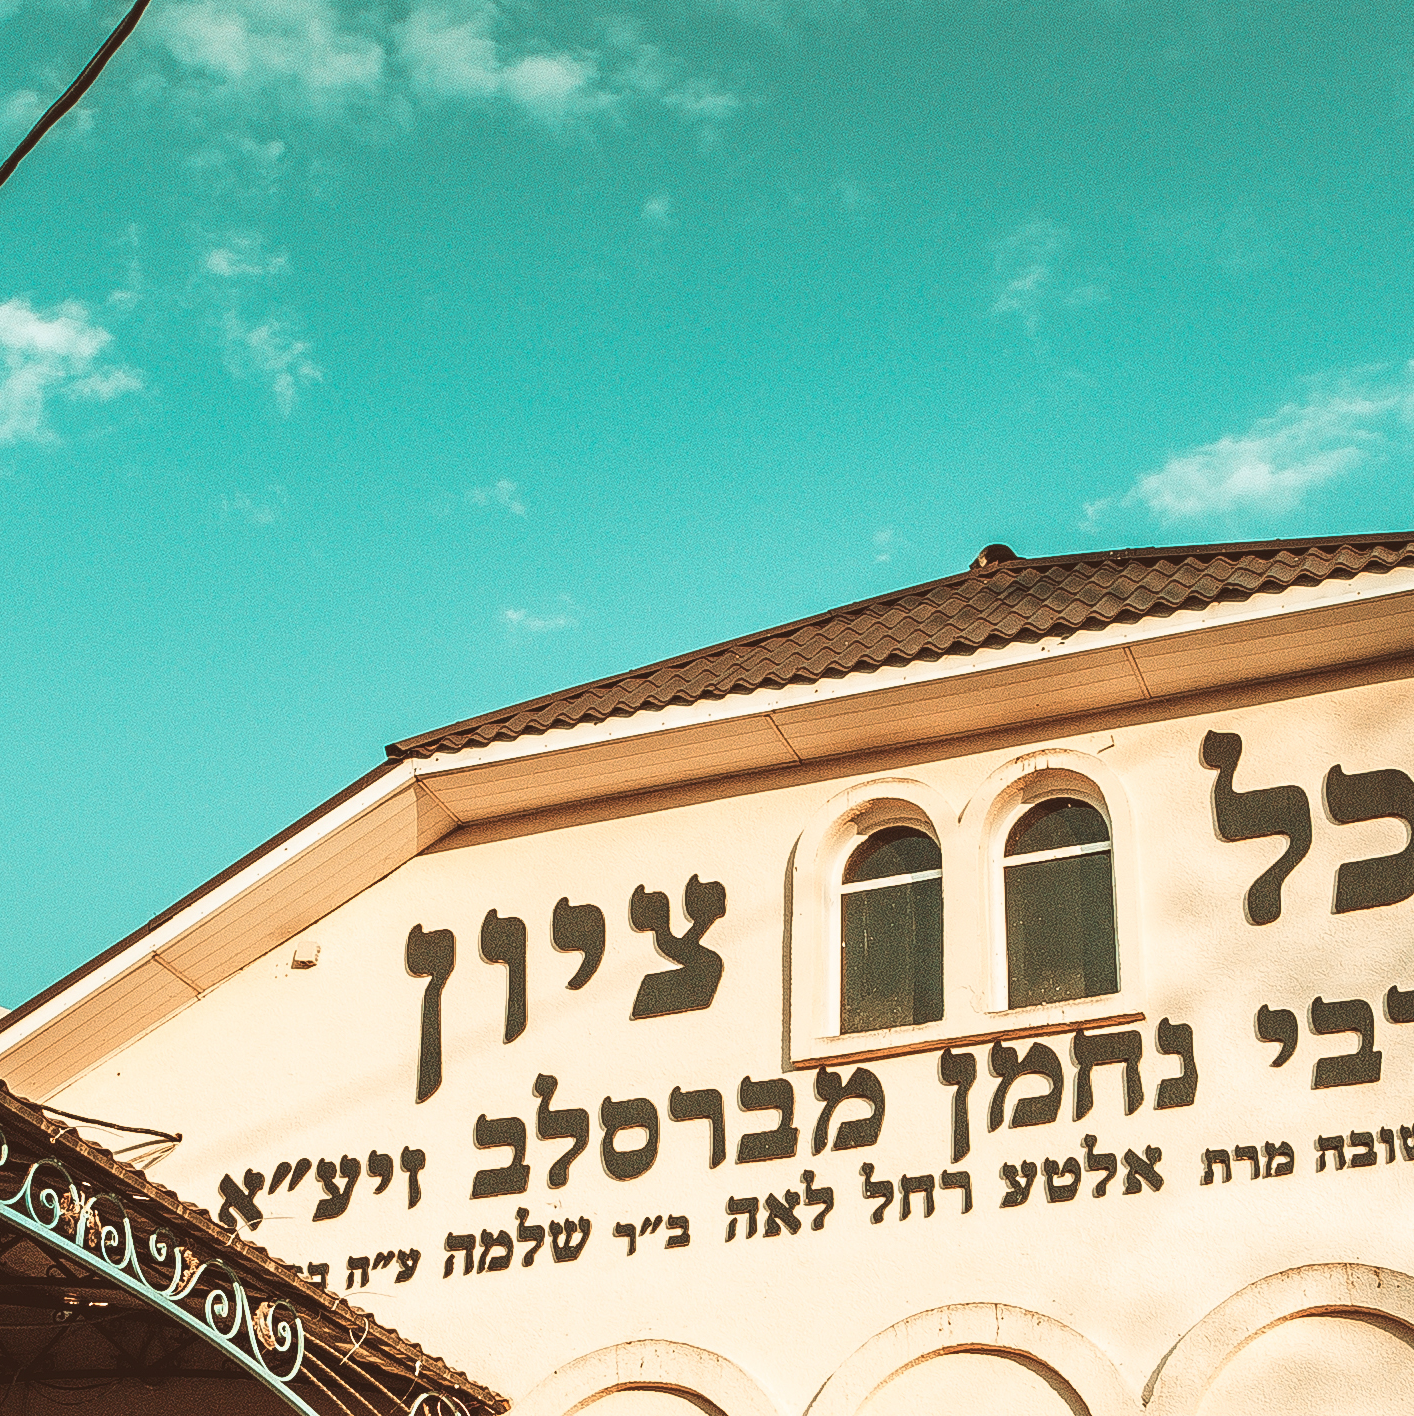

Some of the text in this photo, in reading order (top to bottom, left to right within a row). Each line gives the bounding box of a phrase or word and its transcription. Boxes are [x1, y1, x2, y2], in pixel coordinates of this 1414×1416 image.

[405, 873, 728, 1103] ציון
[937, 1014, 1199, 1164] נחמן
[470, 1064, 888, 1200] מברסלב
[1200, 1139, 1296, 1187] מרת
[724, 1168, 836, 1243] לאה
[859, 1160, 975, 1226] רחל
[999, 1133, 1165, 1209] אלטע
[442, 1206, 593, 1282] שלמה
